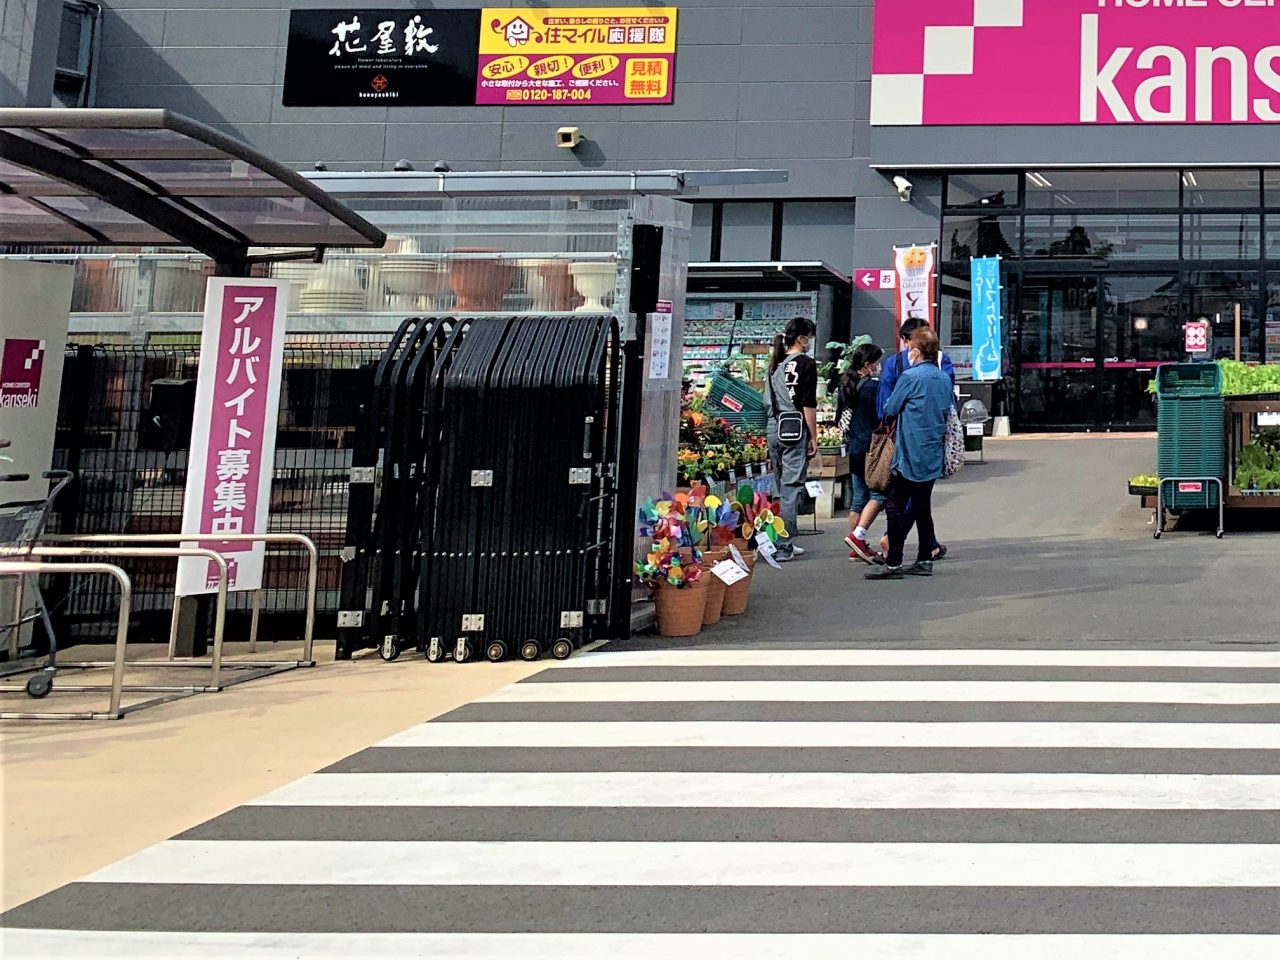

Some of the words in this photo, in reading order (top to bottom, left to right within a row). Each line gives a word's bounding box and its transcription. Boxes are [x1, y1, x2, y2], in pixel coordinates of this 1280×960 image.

[631, 61, 662, 76] 見積
[522, 89, 592, 100] 0120-187-004
[630, 80, 662, 95] 無料
[0, 389, 38, 407] kanseki
[211, 296, 264, 544] アルバイト募集中
